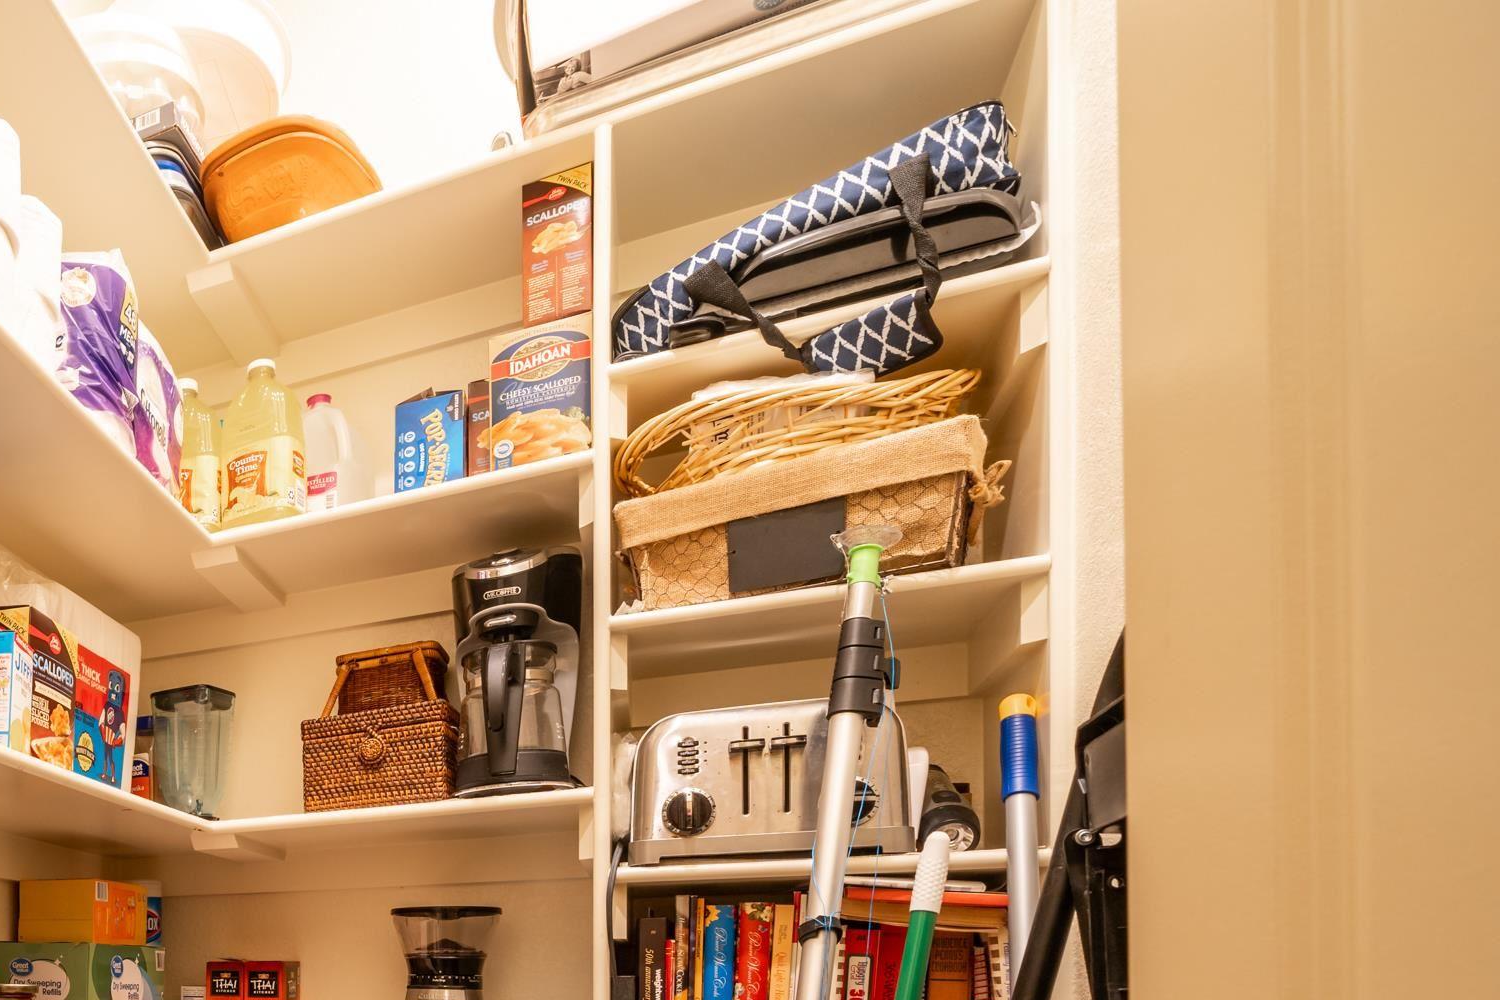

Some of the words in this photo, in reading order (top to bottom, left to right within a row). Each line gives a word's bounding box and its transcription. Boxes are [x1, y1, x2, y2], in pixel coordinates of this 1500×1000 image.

[509, 343, 572, 376] IDAHOAN
[500, 386, 532, 401] CHEESY
[533, 375, 581, 391] SCALLOPED
[229, 453, 265, 471] Country
[235, 463, 259, 475] Time
[0, 612, 13, 625] TWIN
[12, 624, 27, 637] PACK
[33, 653, 74, 688] SCALLOPED
[81, 663, 101, 683] THICK
[31, 707, 50, 721] SLICED
[12, 961, 30, 969] Great
[644, 948, 654, 965] 50th
[713, 951, 728, 978] Woman
[856, 961, 868, 986] Hungry
[42, 987, 62, 996] Refills
[120, 982, 140, 993] Sweeping
[213, 978, 237, 990] THAI
[250, 980, 275, 991] THAI
[712, 977, 727, 998] Cooks
[128, 991, 140, 1000] Refills
